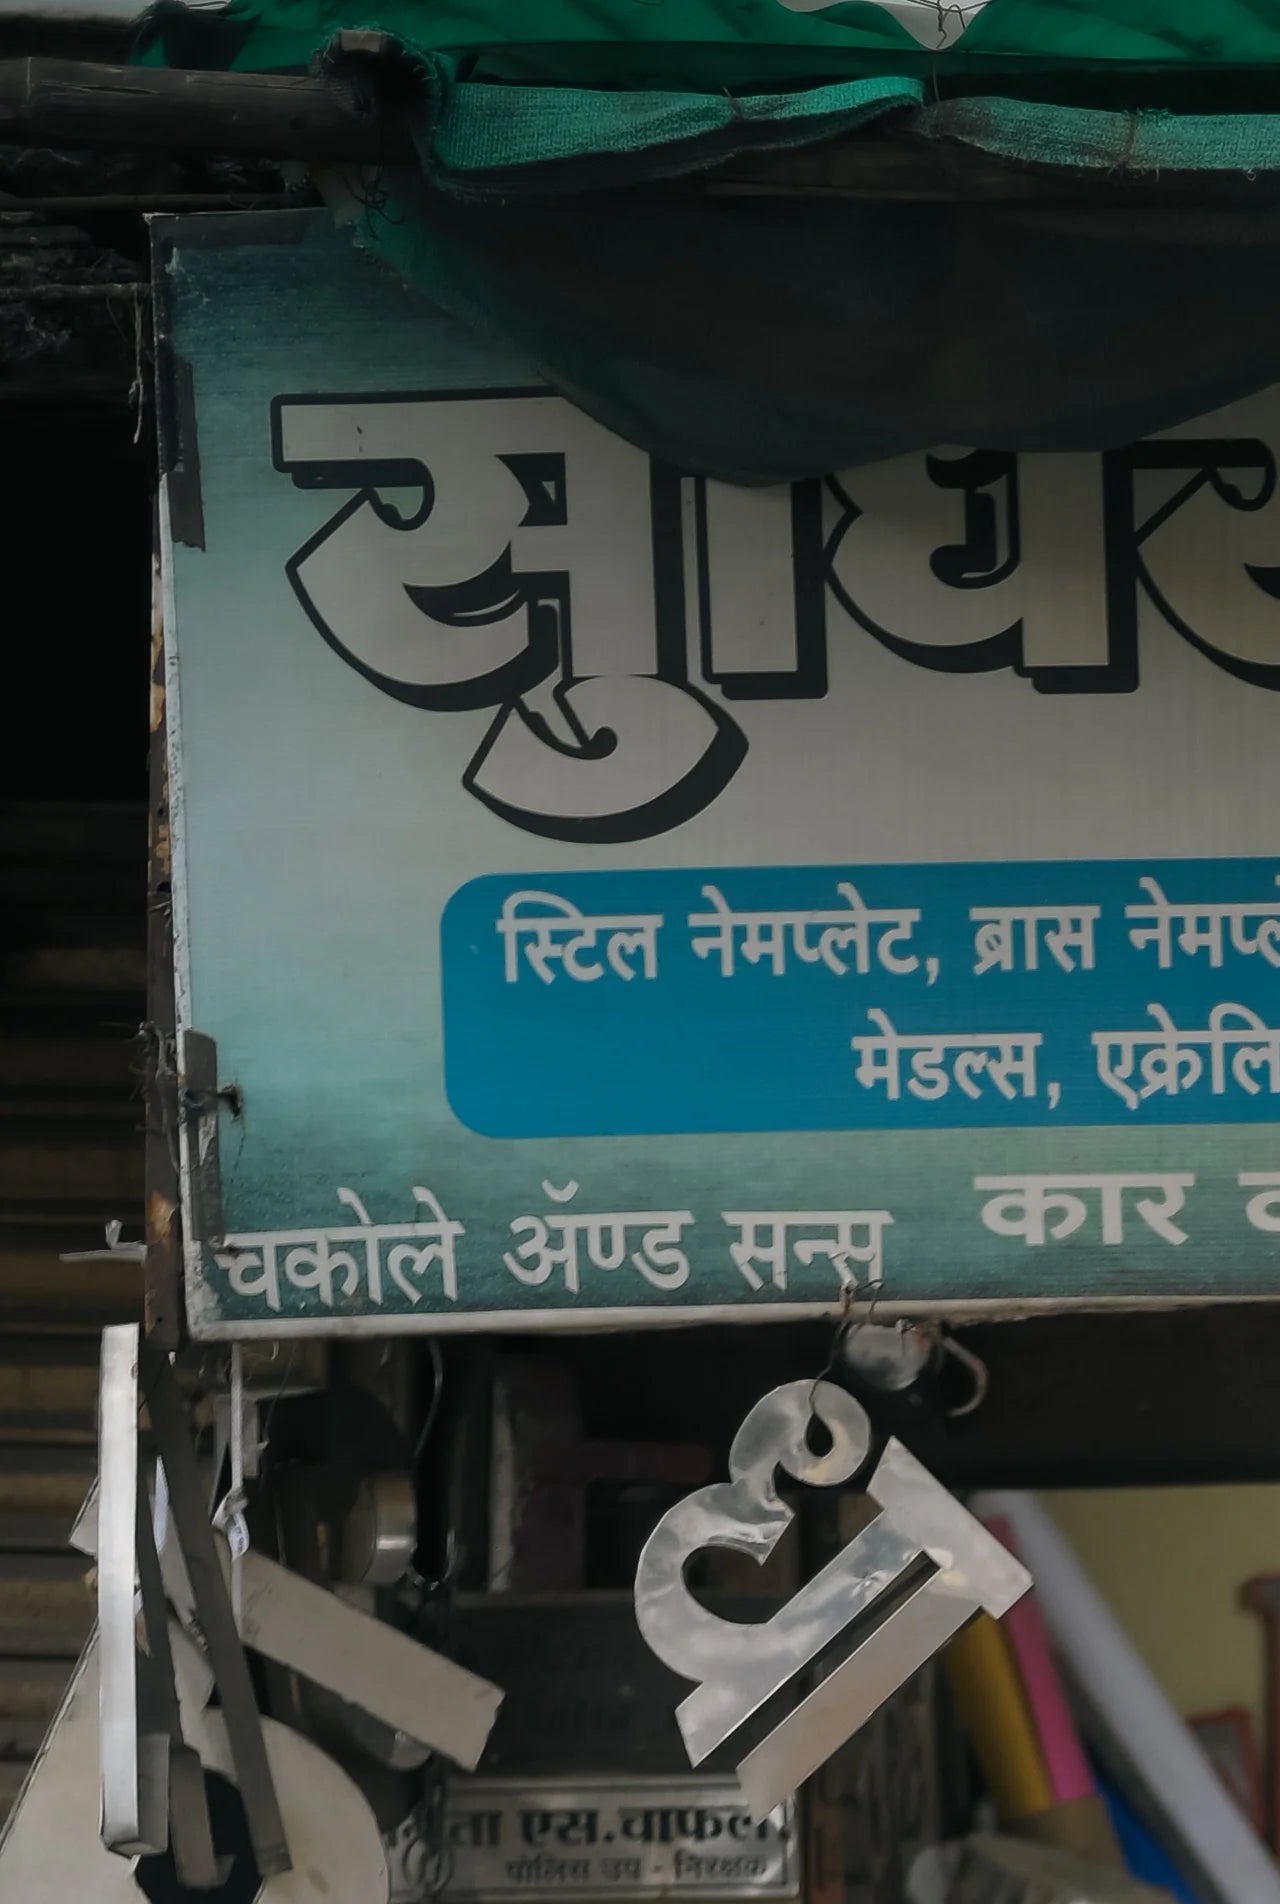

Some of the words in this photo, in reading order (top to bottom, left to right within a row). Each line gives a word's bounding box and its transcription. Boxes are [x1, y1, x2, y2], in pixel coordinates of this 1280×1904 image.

[496, 891, 664, 983] स्टिल
[688, 882, 939, 984] नेमप्लेट,
[970, 905, 1100, 975] ब्रास
[852, 1008, 1060, 1109] मेडल्स,
[215, 1187, 468, 1312] चकोले
[722, 1210, 895, 1291] सन्स
[974, 1173, 1195, 1246] कार
